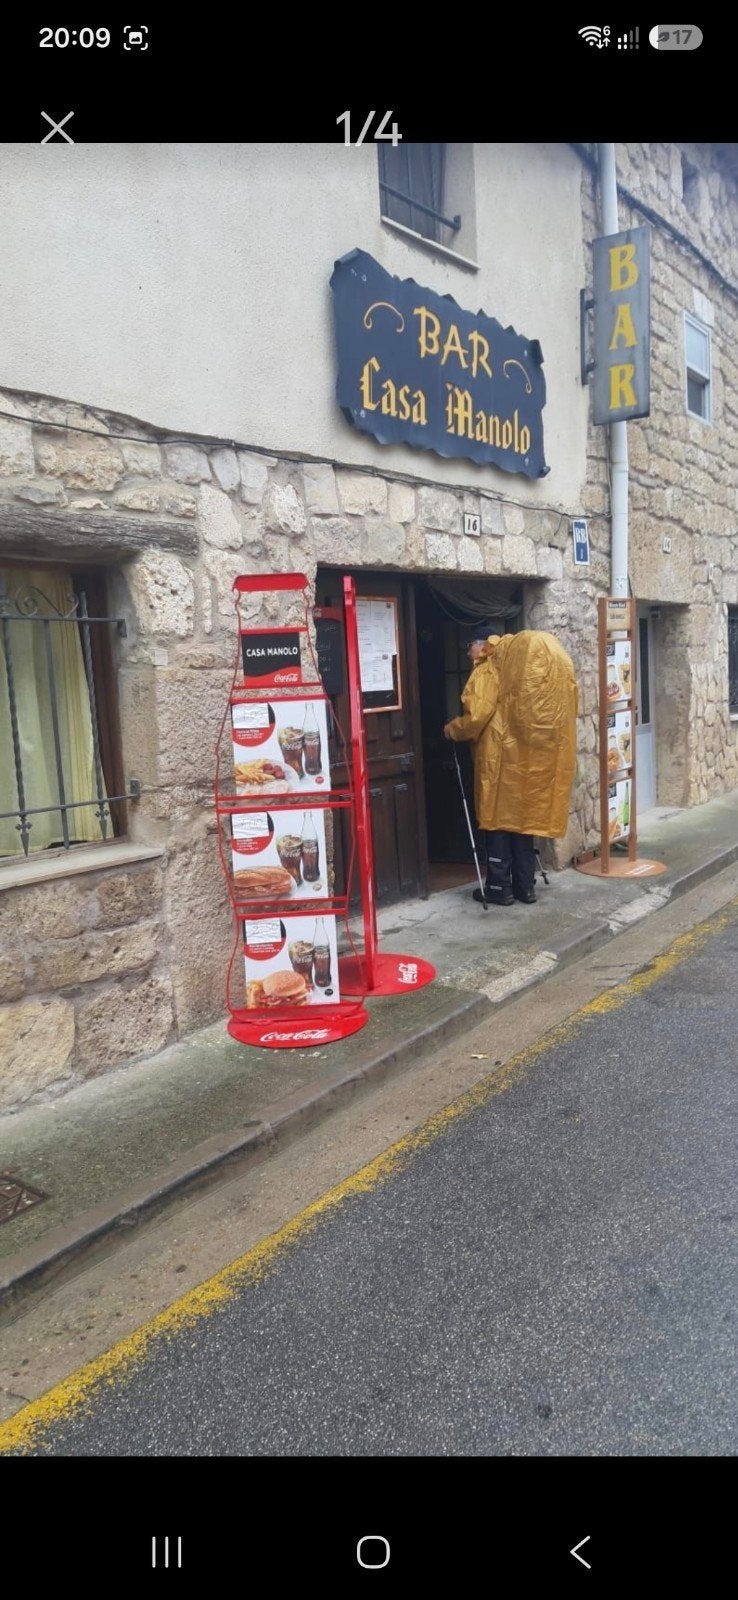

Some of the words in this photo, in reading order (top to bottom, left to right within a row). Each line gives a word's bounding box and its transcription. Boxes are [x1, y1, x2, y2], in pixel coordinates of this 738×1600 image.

[413, 305, 493, 379] BAR
[608, 243, 639, 410] BAR
[360, 356, 428, 426] Casa
[445, 382, 531, 455] Manolo
[467, 518, 478, 532] 16
[246, 648, 266, 658] CASA
[267, 646, 299, 657] MANOLO
[260, 1028, 332, 1042] Coca-Cola
